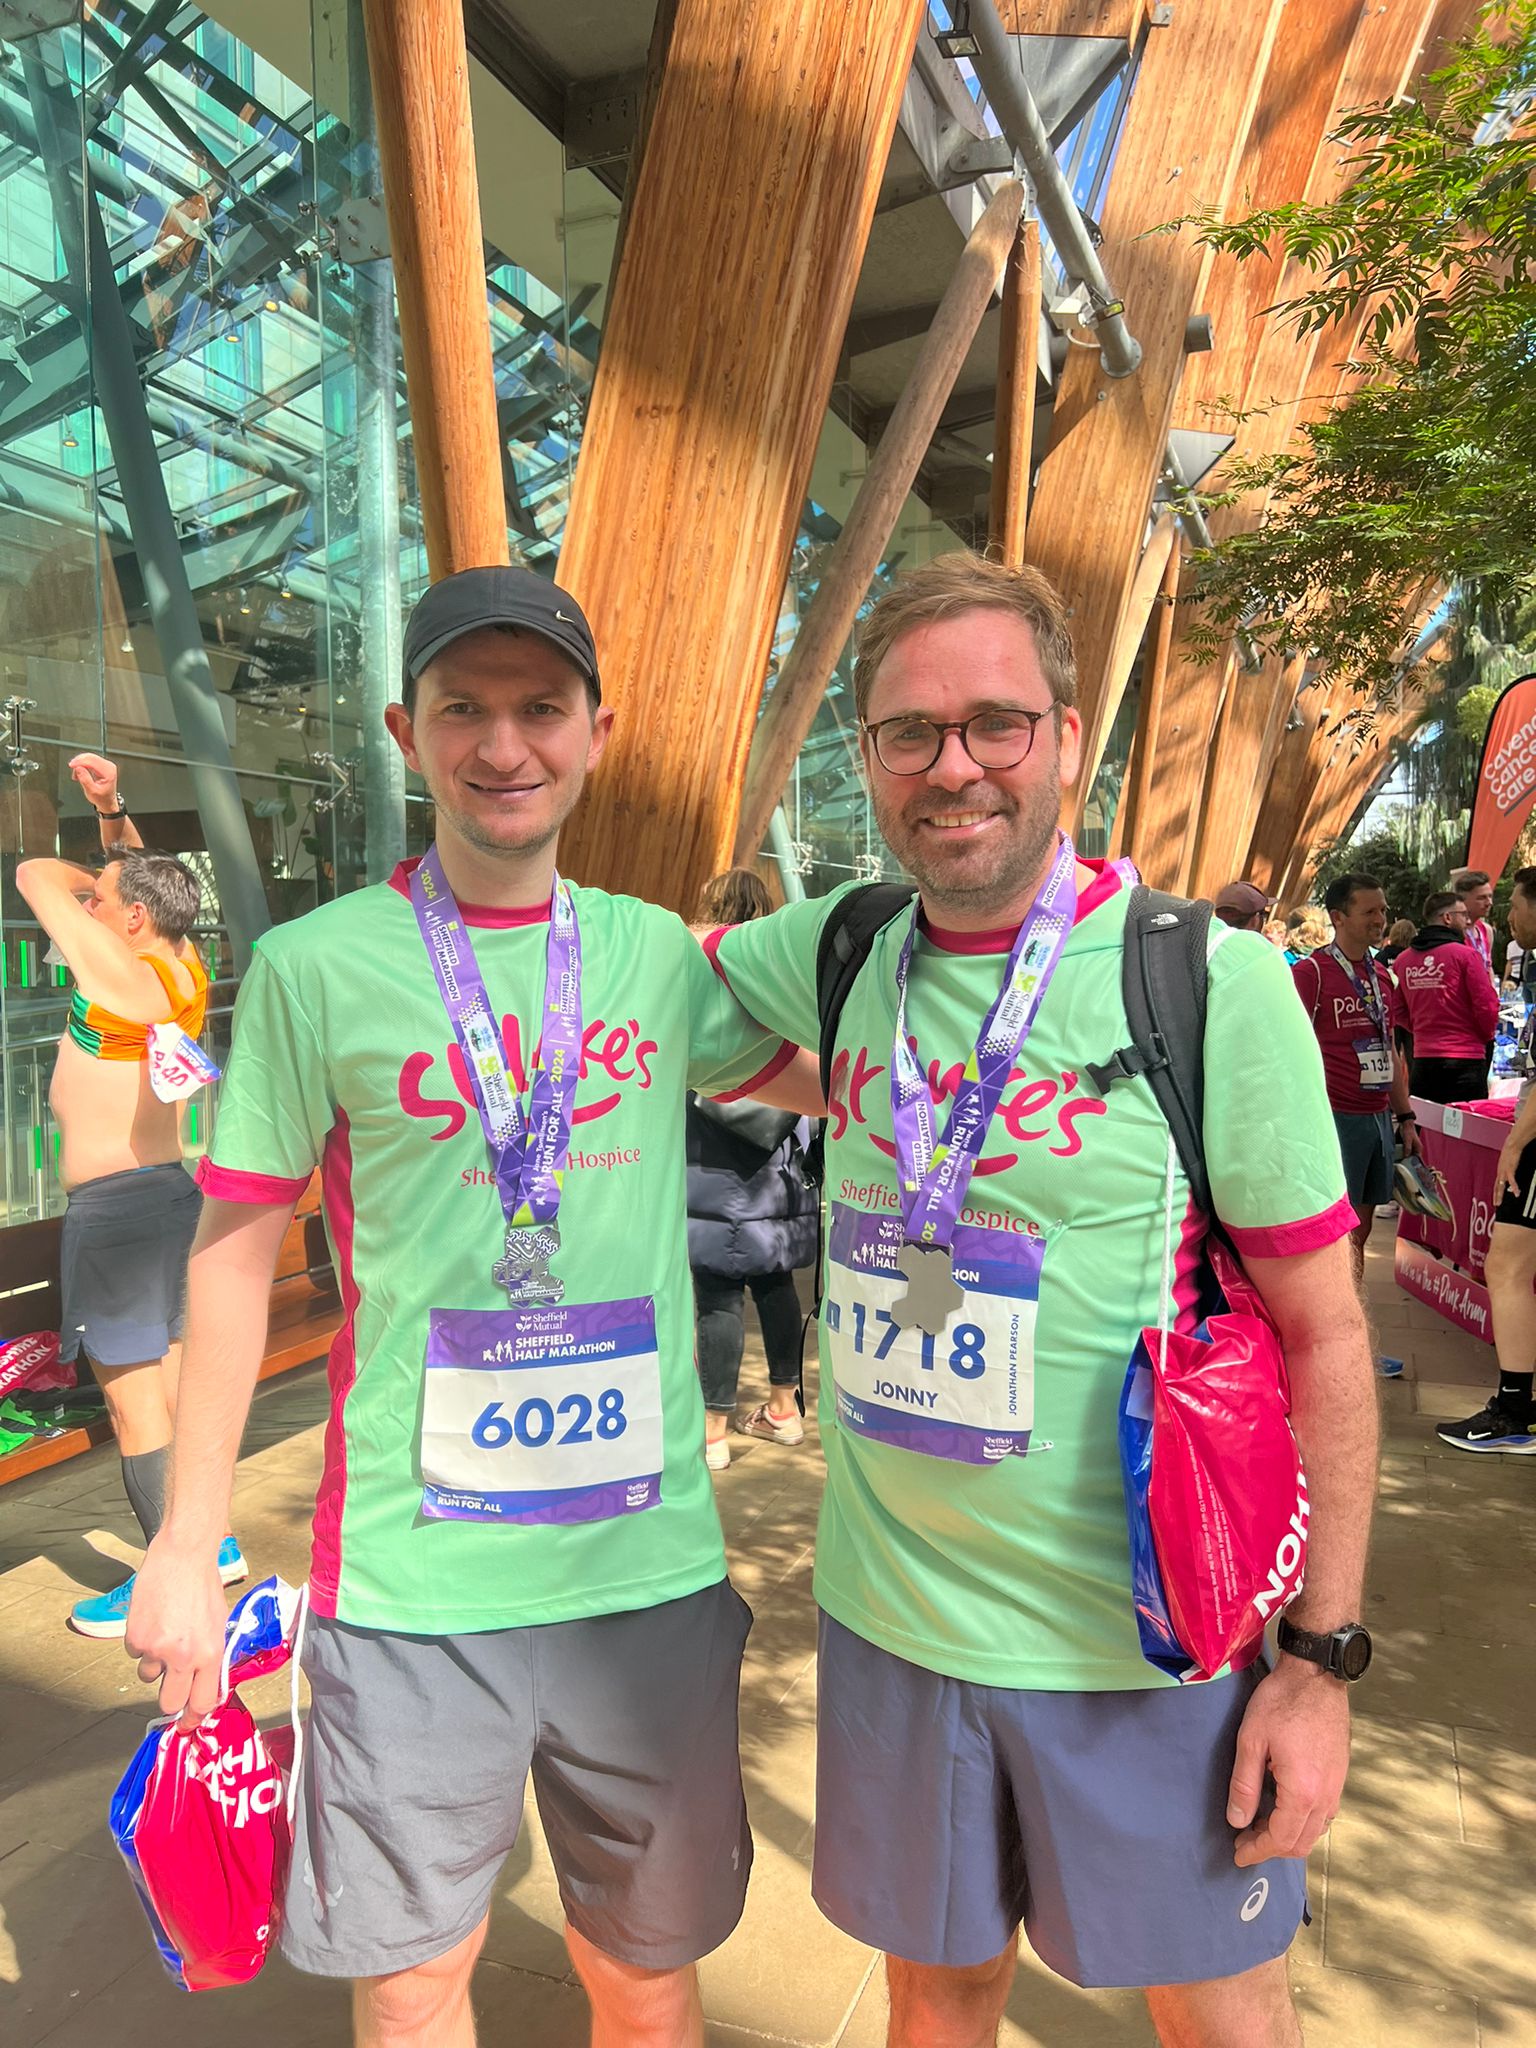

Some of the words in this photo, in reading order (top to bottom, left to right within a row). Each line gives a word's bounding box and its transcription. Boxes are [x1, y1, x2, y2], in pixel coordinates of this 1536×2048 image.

[1496, 767, 1536, 809] care
[421, 869, 438, 900] 2024
[1043, 854, 1068, 906] MARATHON
[438, 926, 458, 965] SHEFFIELD
[429, 929, 444, 950] HALF
[437, 951, 460, 1000] MARATHON
[1406, 963, 1445, 985] paces
[561, 973, 570, 1013] SHEFFIELD
[1333, 994, 1389, 1027] pac
[550, 1049, 565, 1084] 2024
[483, 1076, 499, 1109] Mutual
[493, 1072, 510, 1112] Sheffield
[553, 1091, 564, 1115] ALL
[548, 1116, 560, 1144] FOR
[948, 1127, 966, 1155] RUN
[964, 1129, 974, 1149] Jane
[541, 1145, 556, 1174] RUN
[568, 1146, 641, 1171] Hospice
[937, 1157, 954, 1188] FOR
[840, 1179, 901, 1209] Sheffie
[960, 1207, 1040, 1237] ospice
[926, 1187, 943, 1212] ALL
[921, 1220, 937, 1243] 20
[876, 1256, 900, 1270] HAL
[1422, 1264, 1432, 1292] the
[533, 1311, 567, 1322] Sheffield
[533, 1321, 562, 1331] Mutual
[515, 1334, 574, 1348] SHEFFIELD
[515, 1348, 545, 1360] HALF
[549, 1340, 615, 1358] MARATHON
[853, 1302, 986, 1379] 1718
[1009, 1314, 1020, 1360] PEARSON
[873, 1379, 939, 1408] JONNY
[1008, 1363, 1017, 1416] JONATHAN
[471, 1388, 627, 1450] 6028
[437, 1496, 459, 1507] RUN
[461, 1500, 481, 1509] FOR
[484, 1503, 502, 1513] ALL
